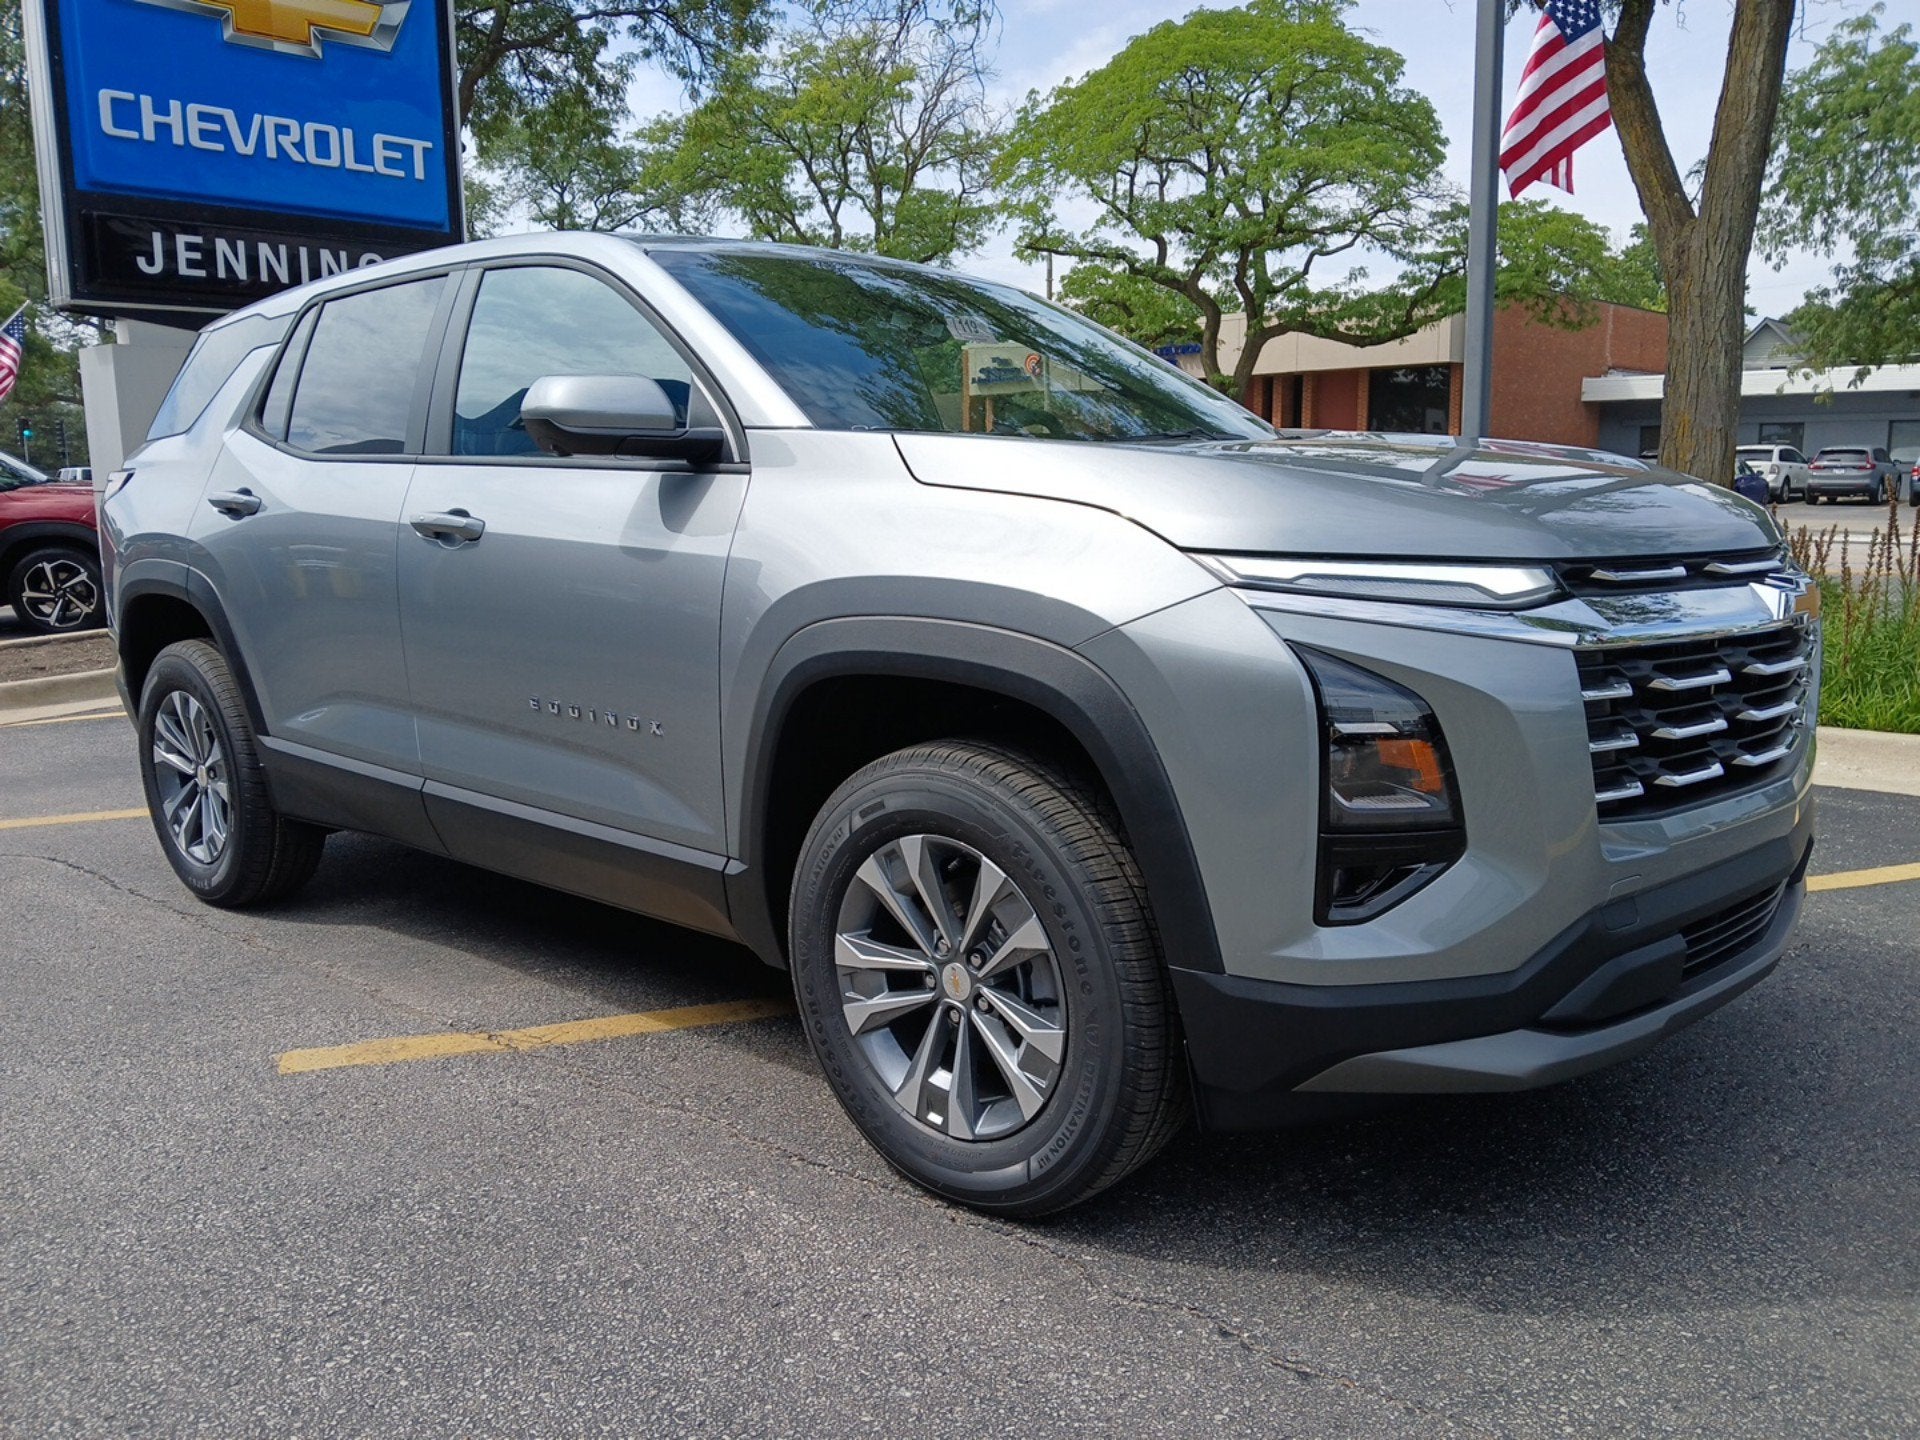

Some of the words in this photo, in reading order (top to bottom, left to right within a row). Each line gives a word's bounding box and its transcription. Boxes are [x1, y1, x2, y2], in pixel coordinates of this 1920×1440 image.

[98, 88, 433, 181] CHEVROLET
[529, 694, 664, 736] EQUINOX
[1011, 840, 1094, 998] Firestone
[1048, 1060, 1096, 1157] DESTINATION
